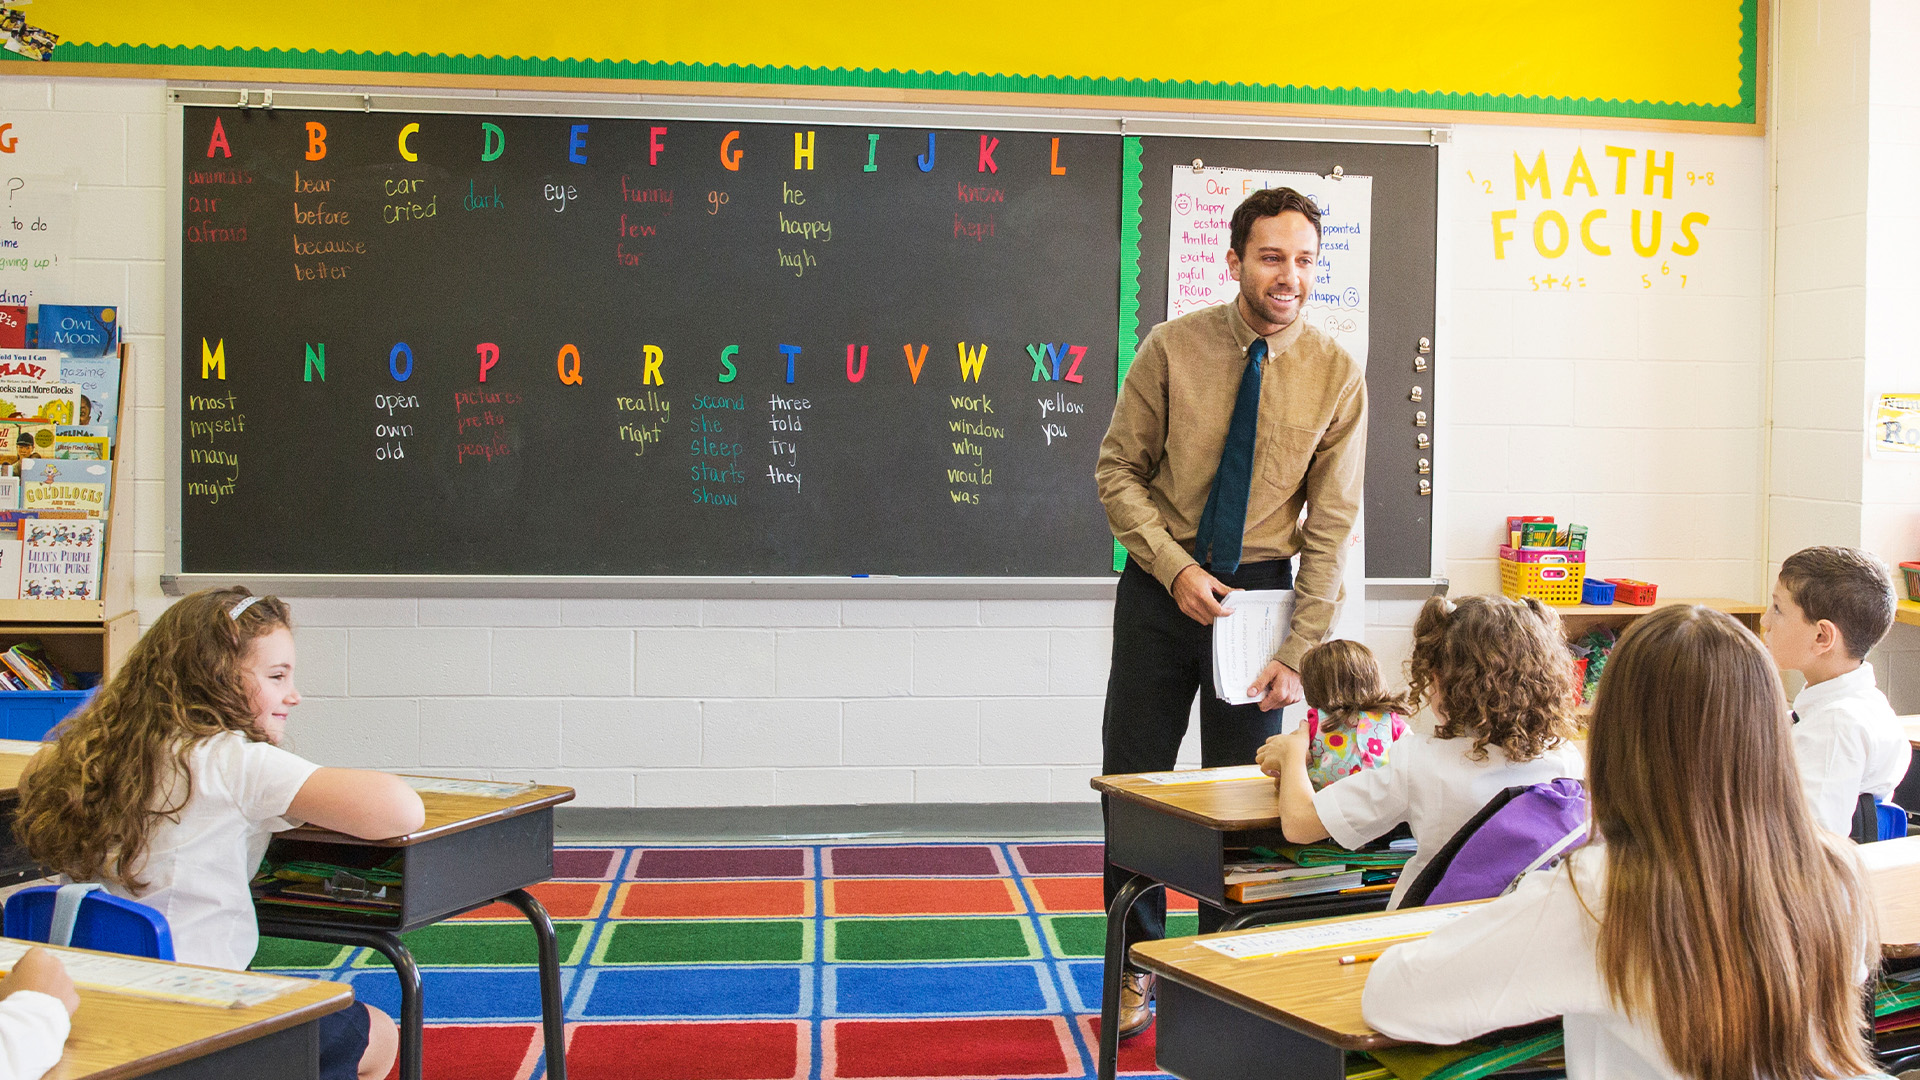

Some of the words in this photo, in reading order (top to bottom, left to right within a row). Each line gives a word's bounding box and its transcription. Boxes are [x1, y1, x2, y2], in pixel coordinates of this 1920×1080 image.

[207, 116, 232, 158] A
[305, 121, 327, 161] B
[398, 122, 420, 162] C
[481, 122, 505, 162] D
[569, 124, 589, 165] E
[650, 126, 667, 166] F
[720, 130, 743, 171] G
[794, 131, 815, 170] H
[863, 134, 879, 172] I
[917, 133, 935, 173] J
[978, 135, 999, 174] K
[1051, 137, 1066, 175] L
[294, 170, 336, 193] bear
[1481, 180, 1493, 194] 2
[1513, 145, 1674, 201] MATH
[1686, 171, 1715, 186] 9-8
[385, 178, 424, 197] car
[464, 178, 504, 211] dark
[620, 174, 674, 216] funny
[783, 181, 806, 205] he
[958, 181, 1006, 203] know
[1206, 178, 1230, 196] Our
[189, 195, 222, 213] air
[544, 184, 578, 212] eye
[707, 190, 729, 215] go
[1195, 198, 1225, 215] happy
[294, 201, 350, 225] before
[383, 195, 436, 224] cried
[1319, 204, 1330, 216] ad
[11, 216, 24, 230] to
[31, 217, 47, 231] do
[187, 219, 248, 243] afraid
[618, 213, 657, 237] few
[779, 211, 832, 242] happy
[954, 212, 995, 242] kept
[1321, 223, 1360, 236] ppointed
[1491, 208, 1710, 260] FOCUS
[0, 239, 19, 249] ime
[293, 234, 367, 255] because
[1181, 231, 1218, 246] thrilled
[1320, 239, 1349, 251] ressed
[777, 248, 817, 277] high
[1180, 251, 1215, 264] excited
[1316, 255, 1330, 272] ely
[294, 262, 351, 281] better
[1175, 267, 1205, 284] joyful
[1315, 273, 1331, 284] set
[1641, 273, 1651, 289] 5
[1660, 260, 1670, 275] 6
[1680, 274, 1687, 288] 7
[1179, 285, 1211, 297] PROUD
[1308, 289, 1340, 306] nhappy
[61, 317, 94, 331] OWL
[54, 331, 100, 344] MOON
[202, 337, 225, 380] M
[304, 342, 325, 382] N
[389, 342, 413, 382] O
[476, 342, 500, 382] P
[557, 343, 583, 386] Q
[643, 344, 664, 386] R
[718, 344, 739, 383] S
[779, 343, 802, 383] T
[846, 344, 869, 383] U
[903, 343, 929, 385] V
[957, 341, 988, 383] W
[1026, 342, 1088, 384] XYZ
[0, 384, 16, 394] ocks
[17, 385, 31, 394] and
[32, 385, 50, 394] More
[51, 386, 73, 394] Clocks
[455, 386, 523, 413] pictures
[189, 390, 237, 410] most
[375, 393, 420, 416] open
[616, 391, 670, 423] really
[692, 393, 745, 410] second
[768, 394, 811, 411] three
[950, 394, 994, 414] work
[1038, 392, 1084, 418] yellow
[190, 414, 245, 444] myself
[375, 423, 413, 437] own
[690, 414, 722, 433] she
[768, 414, 802, 431] told
[949, 418, 1004, 439] window
[619, 422, 661, 457] right
[1041, 423, 1068, 446] you
[375, 441, 405, 461] old
[457, 438, 511, 464] people
[690, 436, 743, 466] sleep
[768, 436, 797, 467] try
[952, 438, 982, 466] why
[190, 449, 239, 481] many
[691, 461, 745, 484] starts
[766, 465, 801, 494] they
[947, 468, 992, 485] would
[26, 486, 103, 504] GOLDILOCKS
[188, 477, 236, 505] might
[692, 486, 737, 506] show
[950, 490, 979, 505] was
[61, 550, 92, 562] PURPLE
[28, 562, 61, 574] PLASTIC
[65, 563, 90, 574] PURSE
